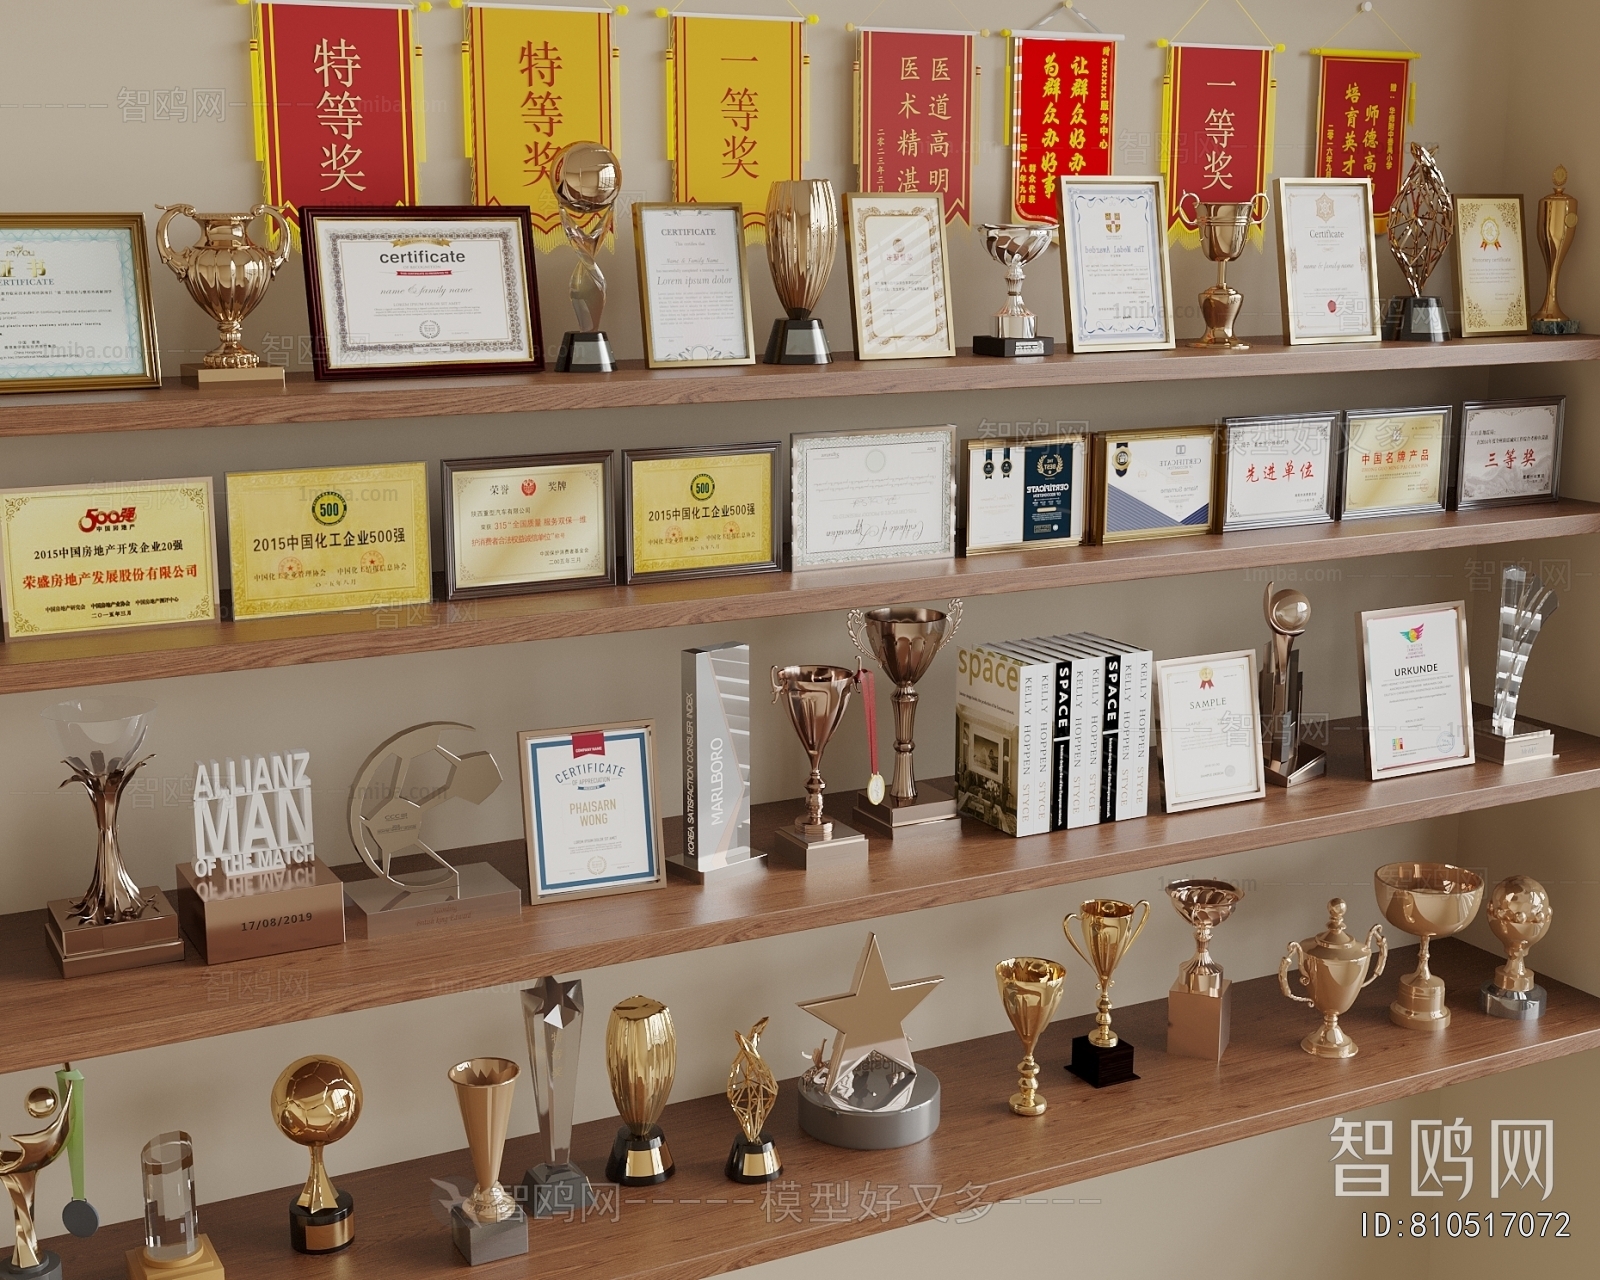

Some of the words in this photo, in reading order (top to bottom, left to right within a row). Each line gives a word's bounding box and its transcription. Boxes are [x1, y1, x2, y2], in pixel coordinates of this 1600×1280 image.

[313, 37, 367, 192] 特等奖
[518, 40, 563, 187] 特等奖
[720, 56, 760, 179] 一等奖
[897, 56, 922, 193] 医术精湛
[927, 57, 952, 193] 医道高明
[1041, 52, 1061, 199] 为群众办好事
[1069, 56, 1090, 176] 让群众好办
[1341, 81, 1361, 176] 培育英才
[1202, 81, 1237, 190] 一等奖
[661, 228, 717, 236] CERTIFICATE
[1309, 229, 1345, 239] Certificate
[379, 250, 466, 264] certificate
[380, 287, 405, 295] name
[417, 285, 447, 297] family
[449, 286, 473, 294] name
[657, 276, 683, 286] Lorem
[685, 276, 710, 288] ipsum
[711, 275, 733, 285] dolor
[1245, 460, 1314, 483] 先进单位
[1362, 449, 1429, 466] 中国名牌产品
[1484, 448, 1536, 470] 三等奖
[548, 480, 567, 492] 奖牌
[695, 482, 710, 494] 500
[319, 502, 339, 517] 500
[648, 502, 756, 522] 2015中国化工企业500强
[34, 539, 184, 560] 2015中国房地产开发企业20强
[253, 527, 406, 552] 2015中国化工企业500强
[22, 564, 198, 590] 荣盛房地产发展股份有限公司
[958, 649, 1019, 692] space
[1091, 668, 1100, 707] KELLY
[1124, 664, 1132, 702] KELLY
[1139, 662, 1148, 700] KELLY
[1394, 663, 1438, 677] URKUNDE
[1024, 677, 1033, 716] KELLY
[1040, 675, 1049, 713] KELLY
[1058, 667, 1069, 729] SPACE
[1075, 670, 1084, 709] KELLY
[1107, 661, 1118, 722] SPACE
[1189, 697, 1227, 710] SAMPLE
[686, 720, 694, 763] CONSUER
[1023, 725, 1031, 776] HOPPEN
[1039, 722, 1048, 773] HOPPEN
[1074, 717, 1082, 768] HOPPEN
[1090, 715, 1098, 766] HOPPEN
[1122, 711, 1131, 761] HOPPEN
[1137, 708, 1146, 758] HOPPEN
[193, 750, 312, 801] ALLIANZ
[555, 762, 626, 784] CERTIFICATE
[572, 778, 579, 786] OF
[579, 776, 611, 785] APPRECIATION
[710, 737, 723, 826] MARLBORO
[1121, 769, 1129, 807] STYCE
[1136, 766, 1144, 804] STYCE
[569, 799, 617, 814] PHAISARN
[686, 765, 695, 825] SATISFACTION
[1022, 784, 1030, 823] STYCE
[1038, 781, 1046, 820] STYCE
[1073, 776, 1081, 814] STYCE
[1089, 774, 1097, 812] STYCE
[193, 787, 314, 861] MAN
[579, 813, 608, 827] WONG
[194, 858, 217, 878] OF
[221, 853, 253, 877] THE
[257, 843, 315, 870] MATCH
[687, 827, 695, 856] KOREA
[240, 912, 314, 932] 17/08/2019
